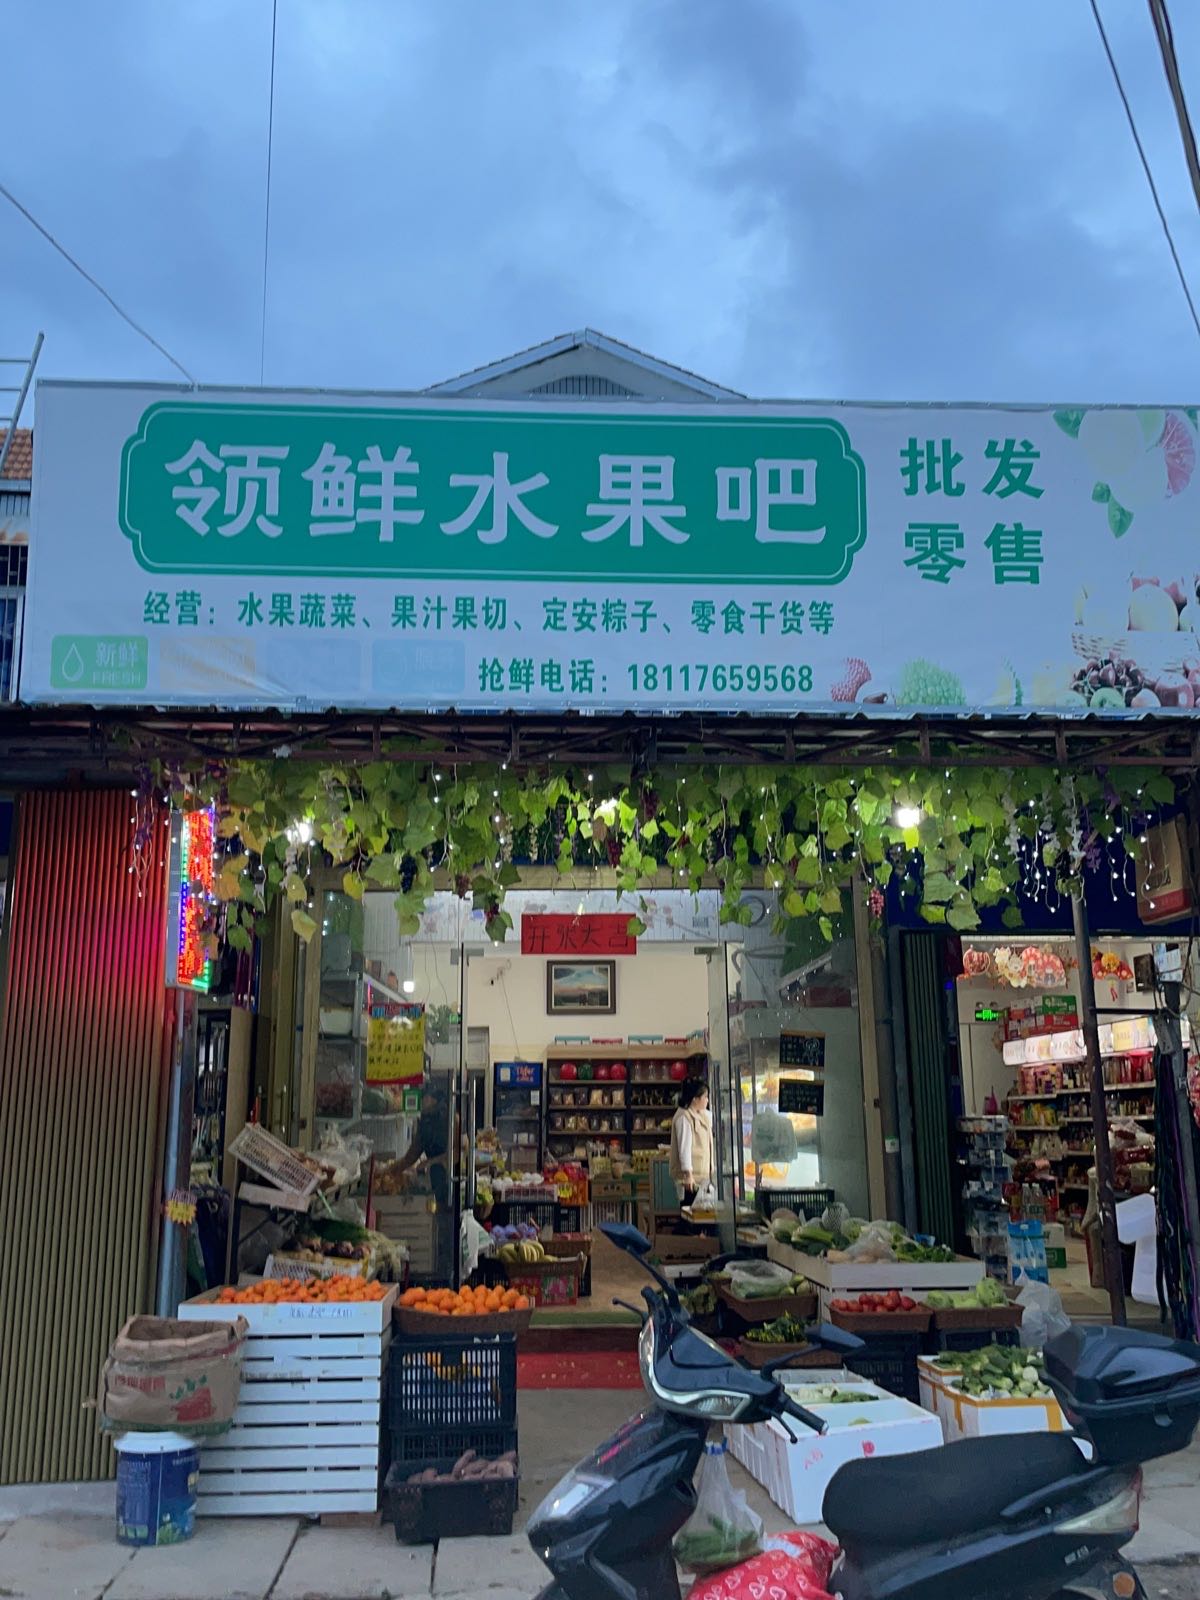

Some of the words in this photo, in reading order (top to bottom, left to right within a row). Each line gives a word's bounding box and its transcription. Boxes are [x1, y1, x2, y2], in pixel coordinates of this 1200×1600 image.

[165, 439, 827, 546] 领鲜水果吧
[899, 437, 1045, 499] 批发
[903, 522, 1044, 585] 零售
[95, 640, 139, 668] 新鲜
